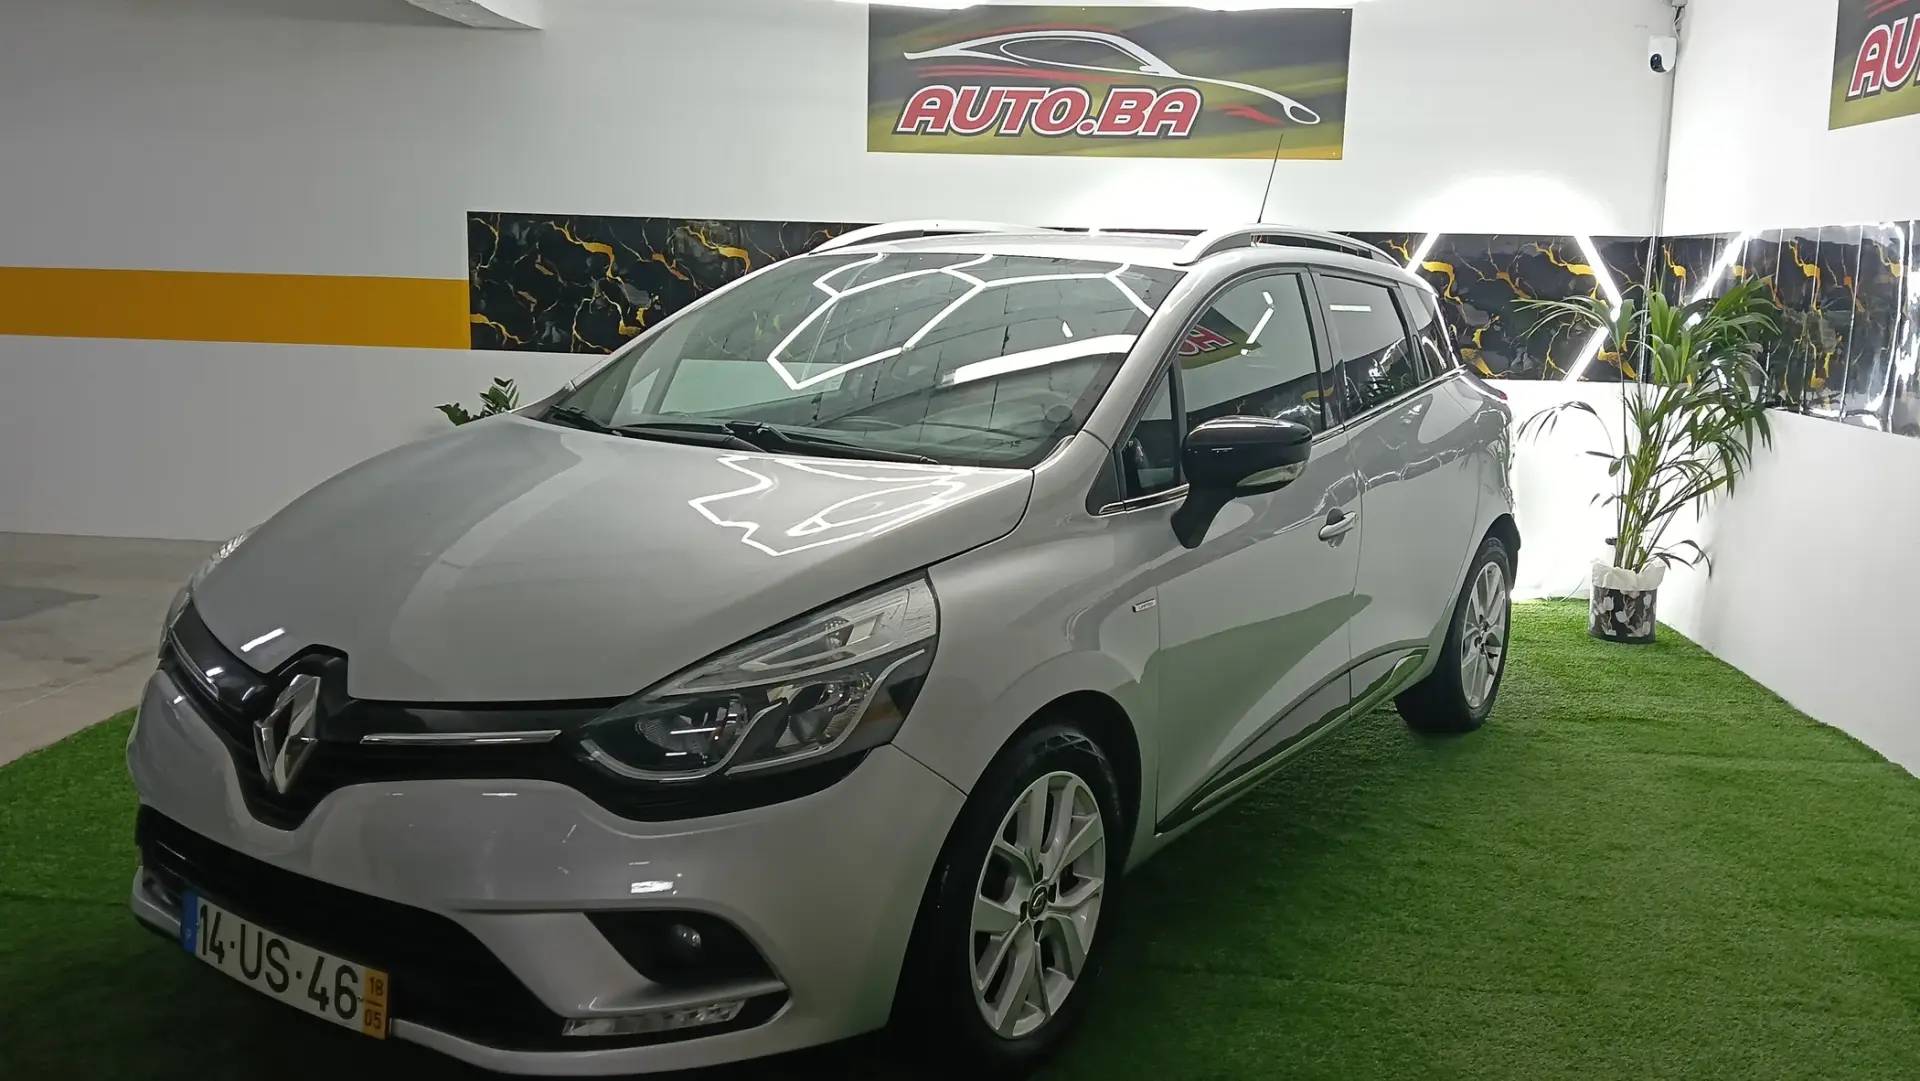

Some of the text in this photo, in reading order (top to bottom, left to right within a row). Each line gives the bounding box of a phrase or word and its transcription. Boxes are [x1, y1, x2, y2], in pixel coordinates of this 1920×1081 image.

[1846, 13, 1920, 99] AU
[896, 85, 1203, 138] AUTO.BA
[364, 1008, 382, 1030] 05
